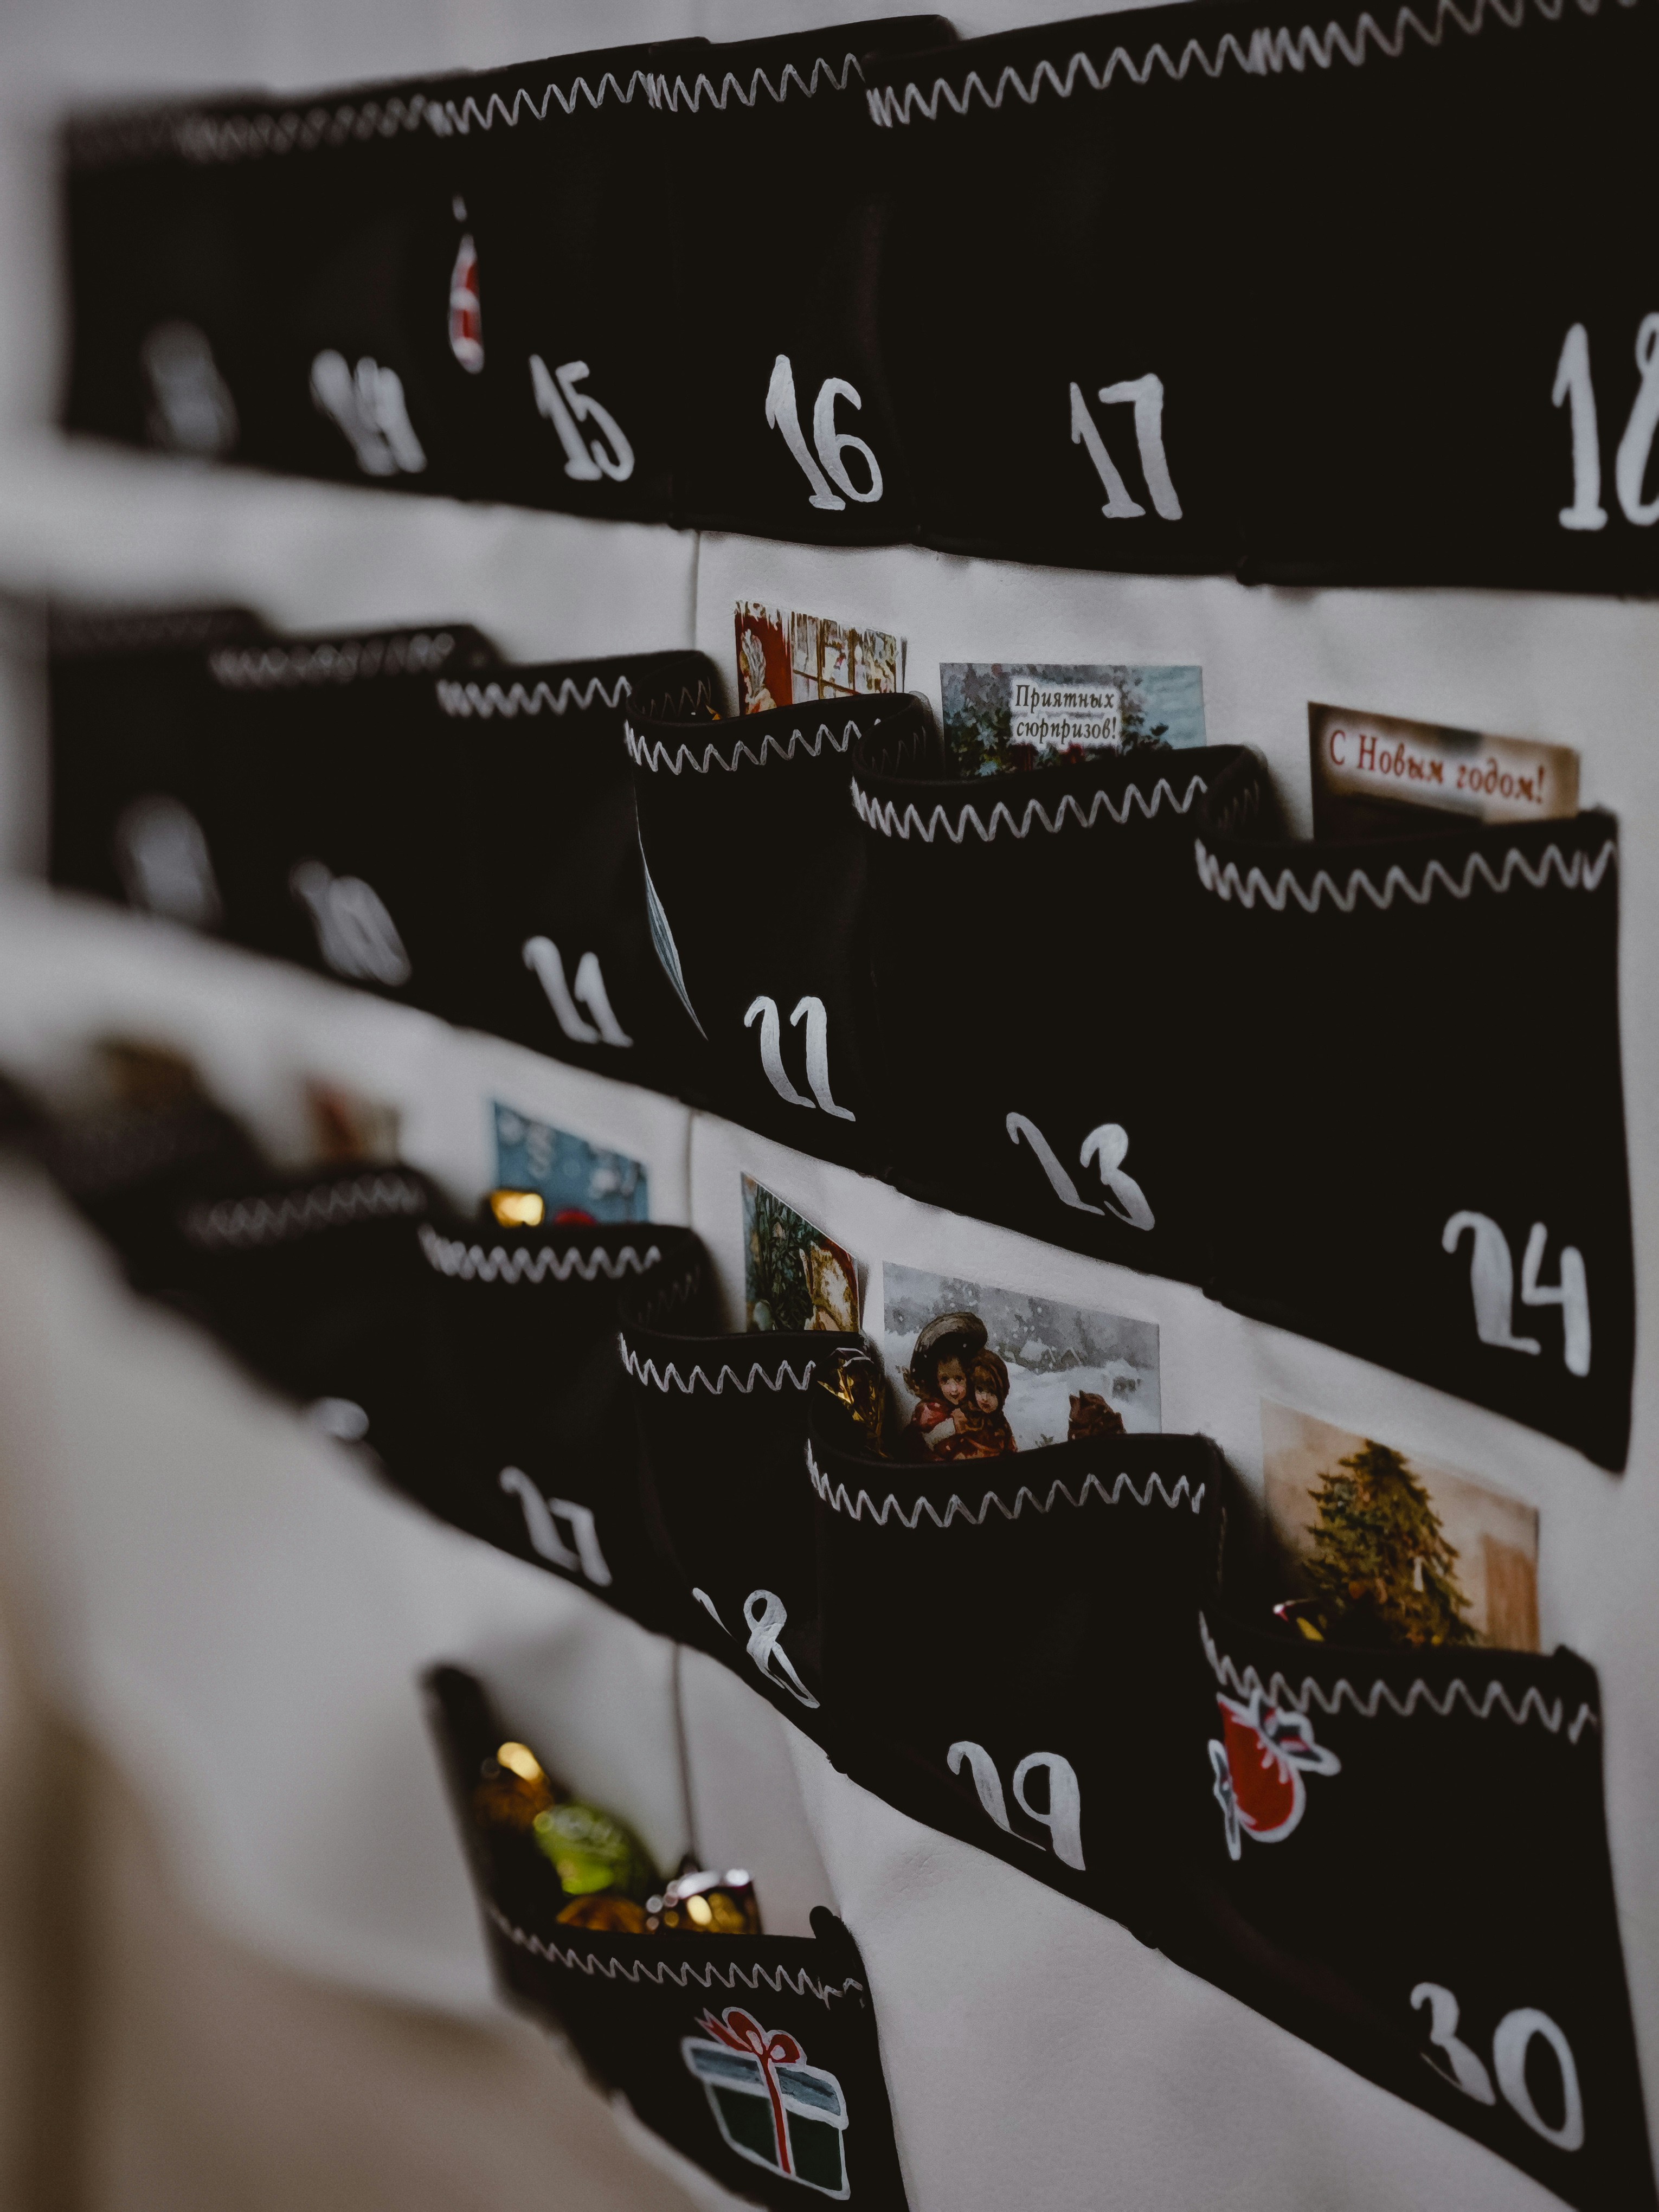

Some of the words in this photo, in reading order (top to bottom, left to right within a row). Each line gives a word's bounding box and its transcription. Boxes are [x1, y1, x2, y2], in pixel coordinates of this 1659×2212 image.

[529, 353, 635, 482] 15
[764, 353, 884, 511] 16
[1069, 372, 1184, 521] 17
[1015, 684, 1115, 713] Приятных
[1016, 716, 1117, 744] сюрпризов!
[1329, 729, 1346, 766] С
[1356, 734, 1444, 785] Новым
[1457, 757, 1545, 803] годом!
[1441, 1210, 1592, 1378] 24
[1410, 1982, 1585, 2152] 30
